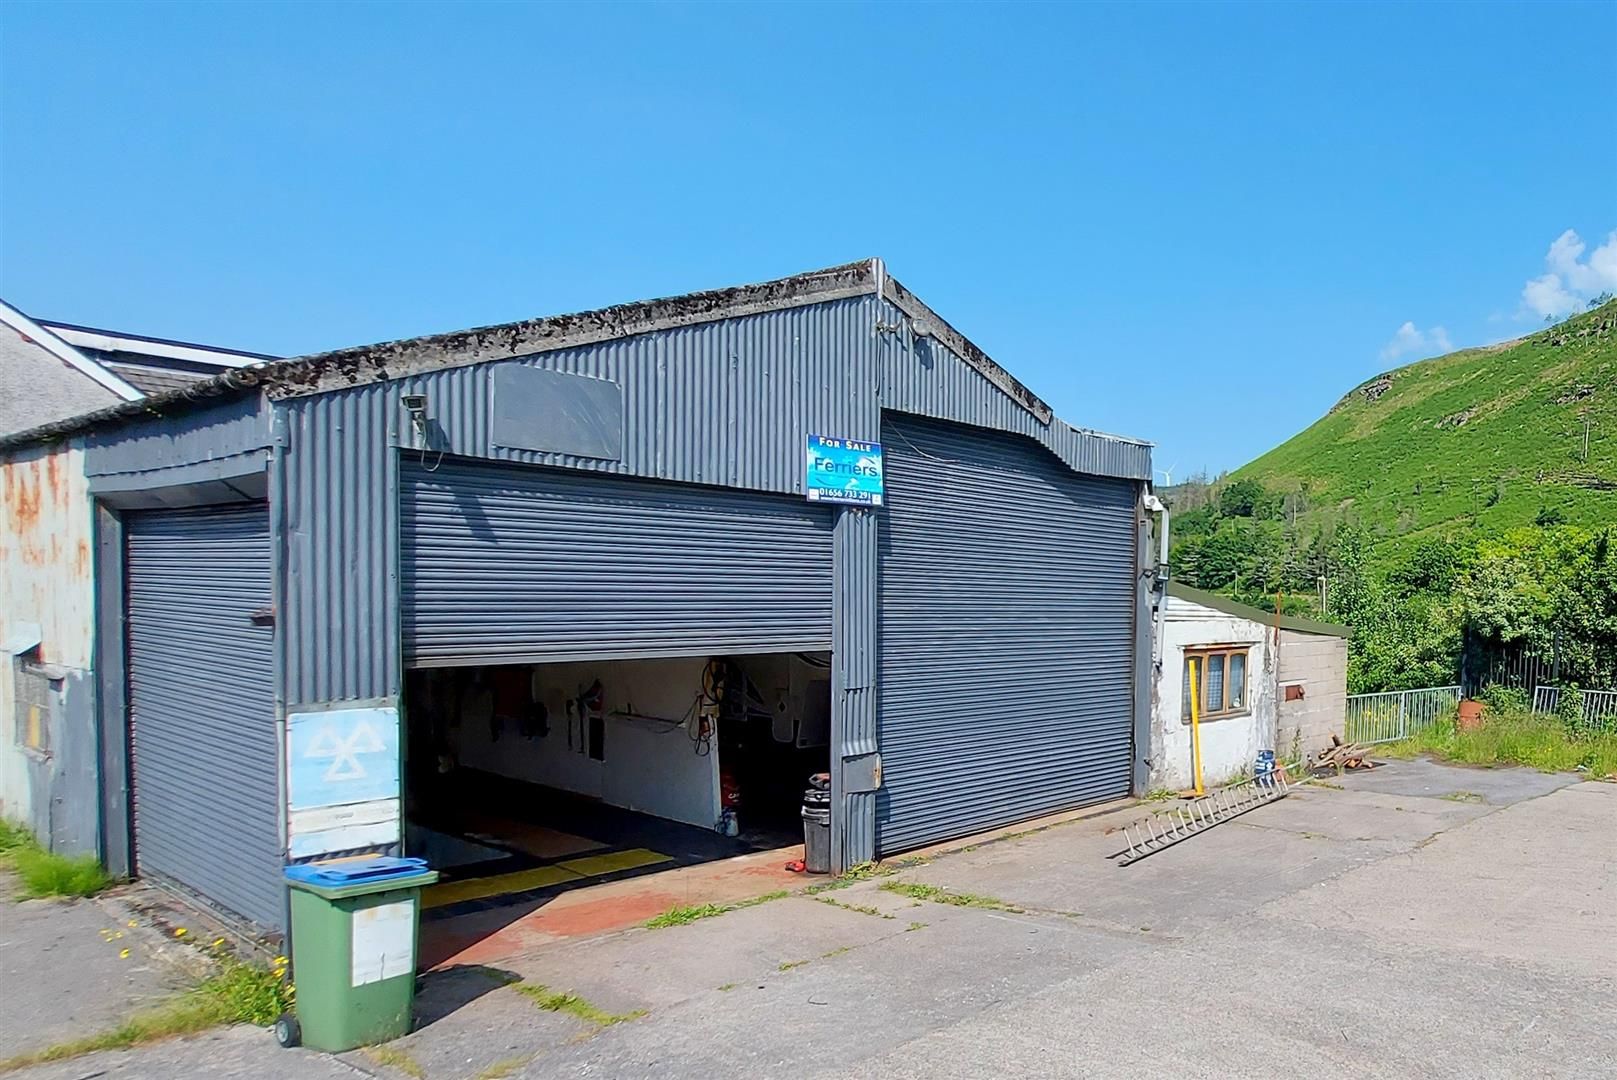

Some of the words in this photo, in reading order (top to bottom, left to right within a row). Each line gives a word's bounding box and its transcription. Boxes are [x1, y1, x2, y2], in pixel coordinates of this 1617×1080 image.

[819, 437, 840, 448] FOR
[845, 440, 871, 452] SALE
[814, 457, 878, 477] Ferriers
[819, 487, 843, 497] 01656
